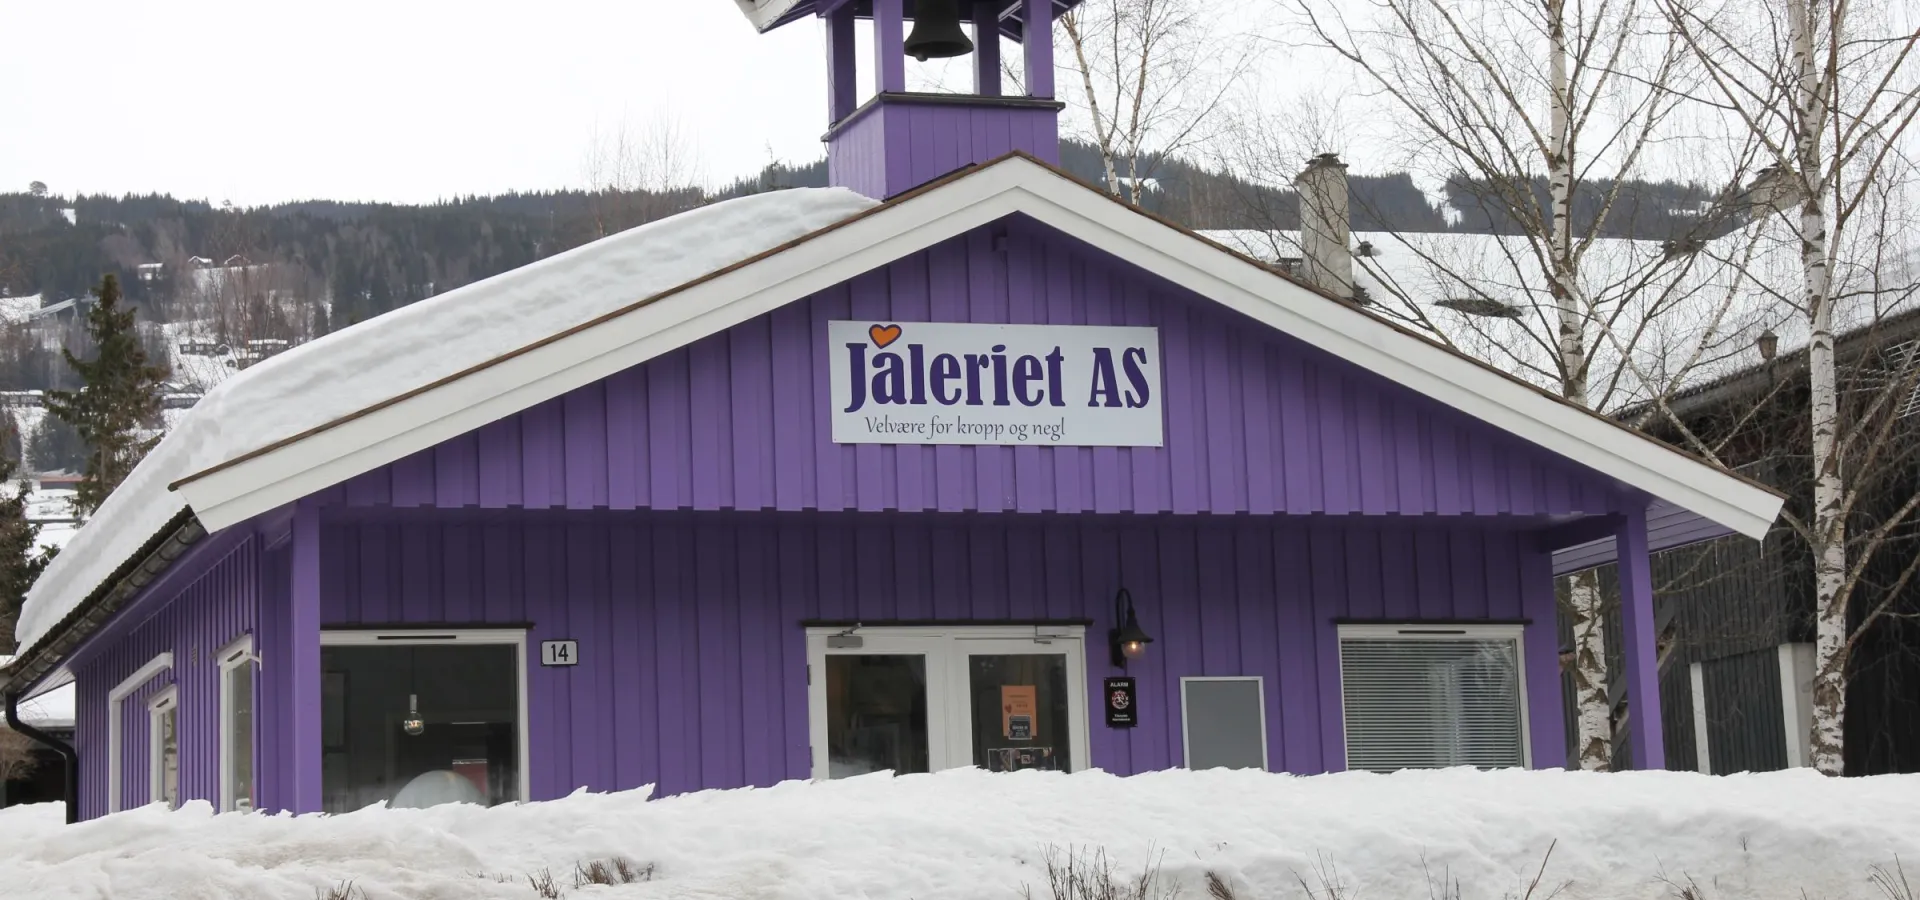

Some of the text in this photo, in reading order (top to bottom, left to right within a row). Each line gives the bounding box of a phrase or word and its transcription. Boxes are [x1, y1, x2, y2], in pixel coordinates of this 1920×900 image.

[1088, 347, 1150, 409] AS
[865, 415, 1066, 441] Velvære for kropp og negl
[551, 643, 569, 662] 14
